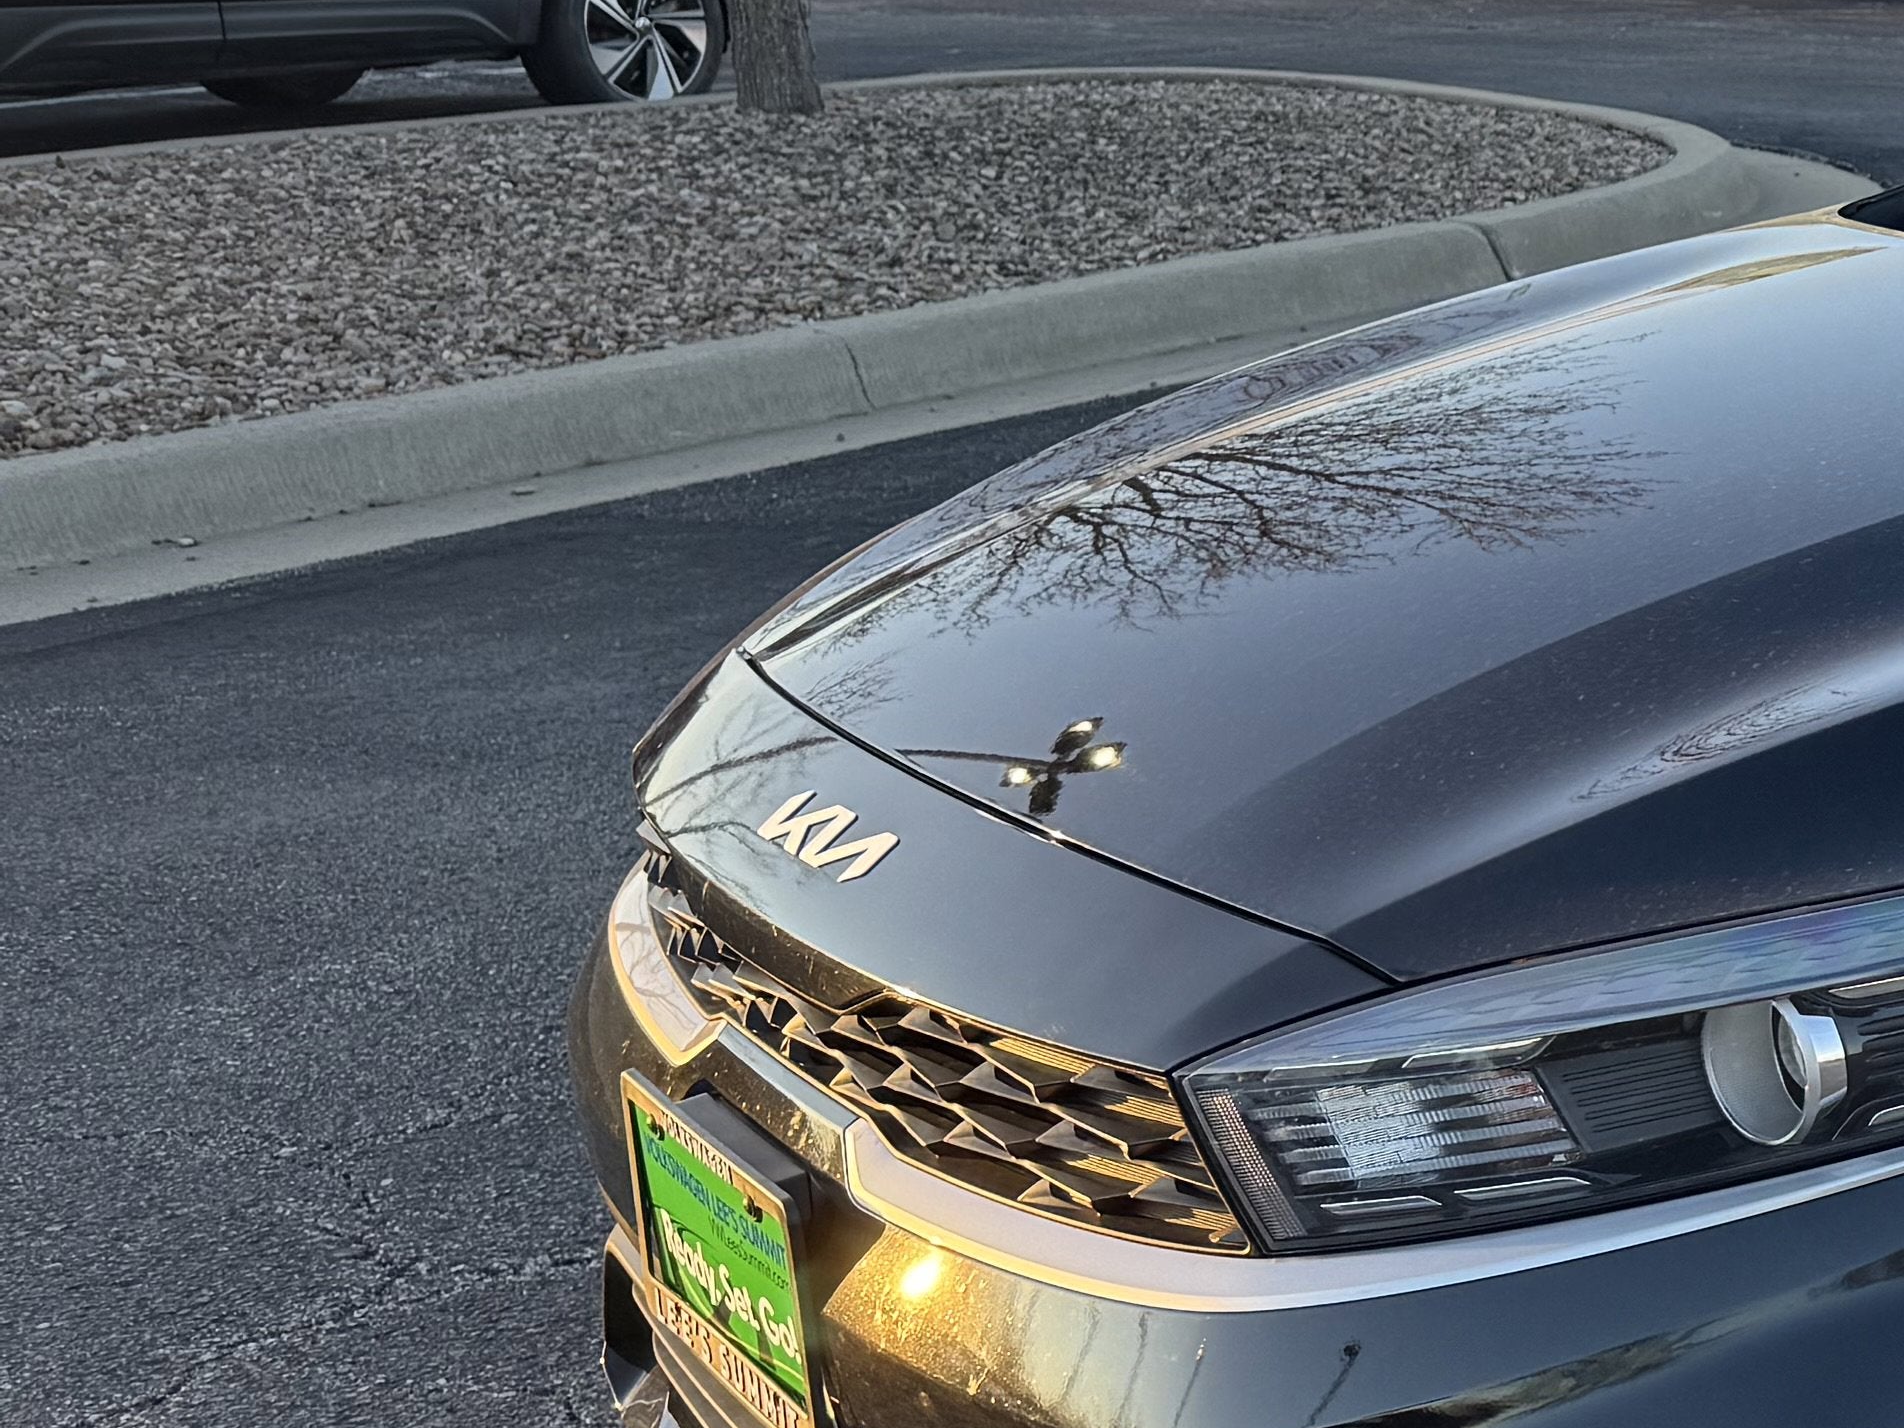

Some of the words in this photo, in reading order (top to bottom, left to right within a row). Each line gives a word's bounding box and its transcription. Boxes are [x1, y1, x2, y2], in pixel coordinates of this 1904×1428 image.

[757, 789, 900, 884] KIA
[654, 1286, 713, 1364] LEE'S
[758, 1296, 803, 1365] Go!
